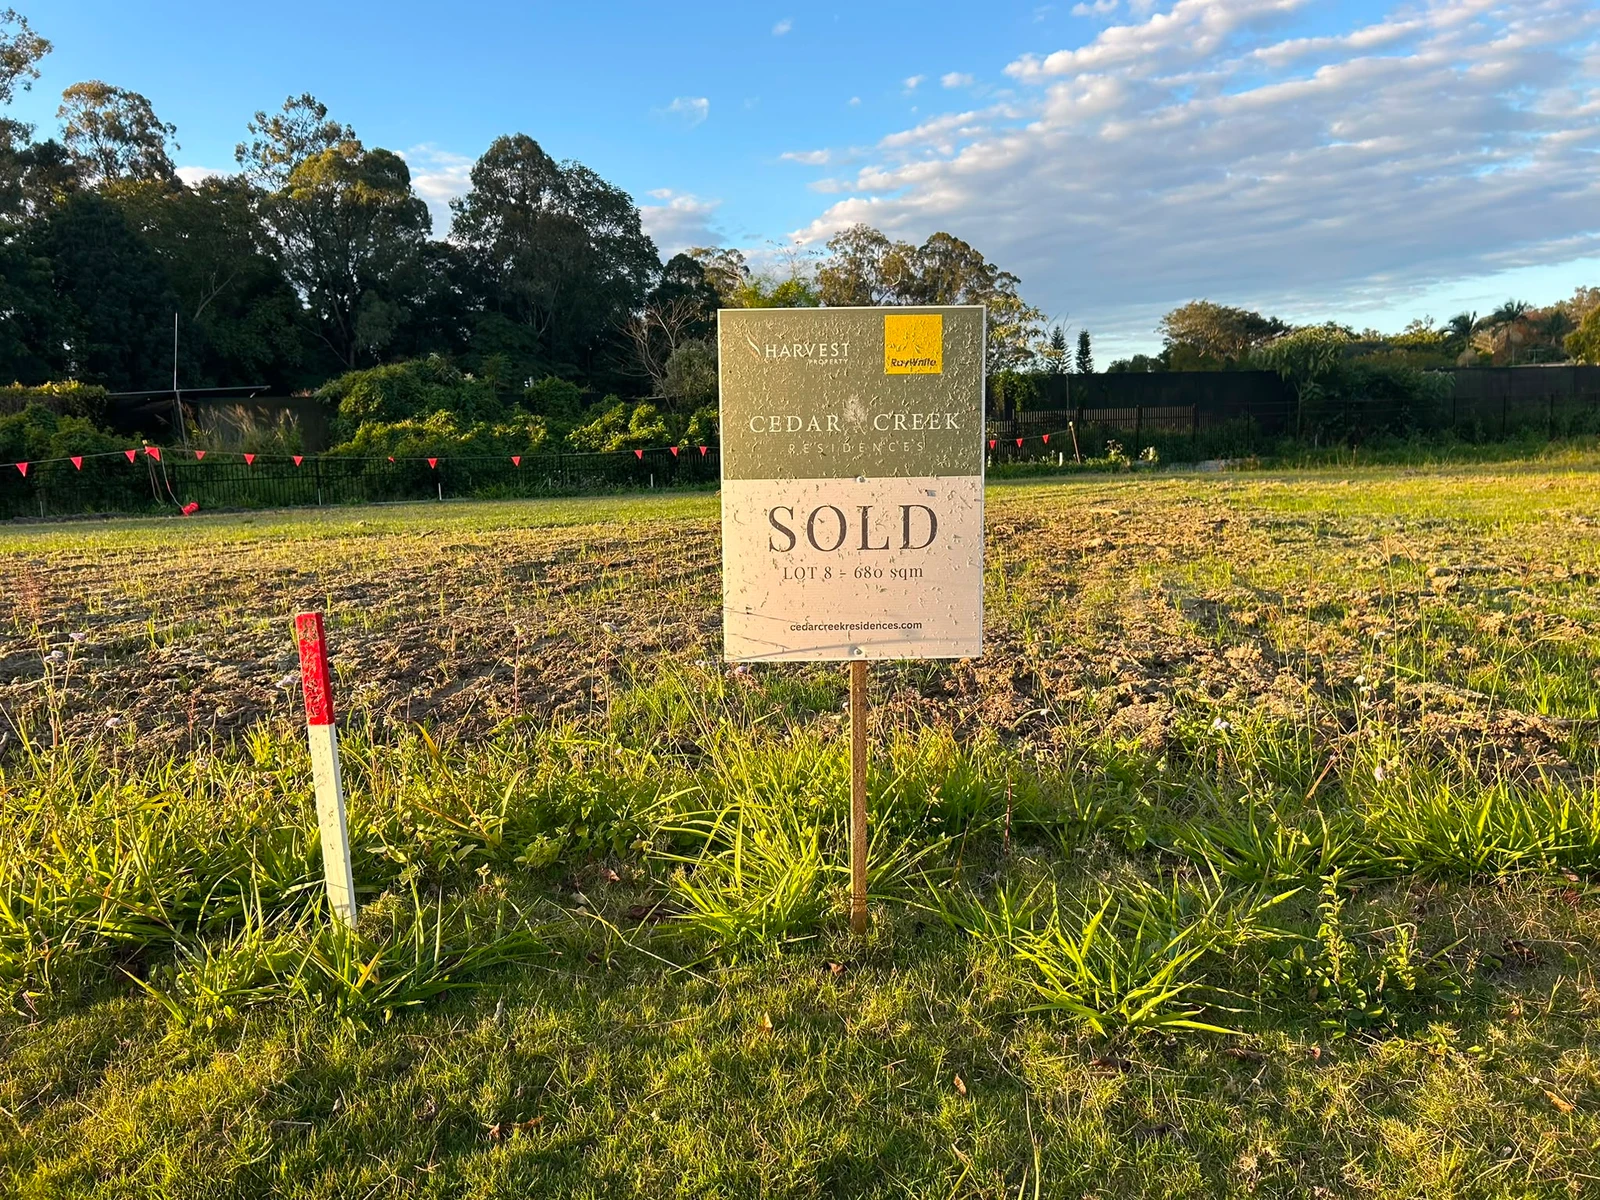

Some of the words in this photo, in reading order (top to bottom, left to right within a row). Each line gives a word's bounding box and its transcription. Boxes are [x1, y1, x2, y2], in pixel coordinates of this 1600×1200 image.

[765, 343, 849, 358] HARVEST
[749, 415, 842, 433] CEDAR
[873, 412, 961, 432] CREEK
[788, 441, 924, 454] RESIDENCES
[768, 504, 938, 553] SOLD
[783, 566, 818, 580] LOT
[824, 566, 833, 579] 8
[854, 565, 883, 579] 680
[889, 566, 924, 581] sqm
[789, 620, 923, 632] cedarcreekresidences.com
